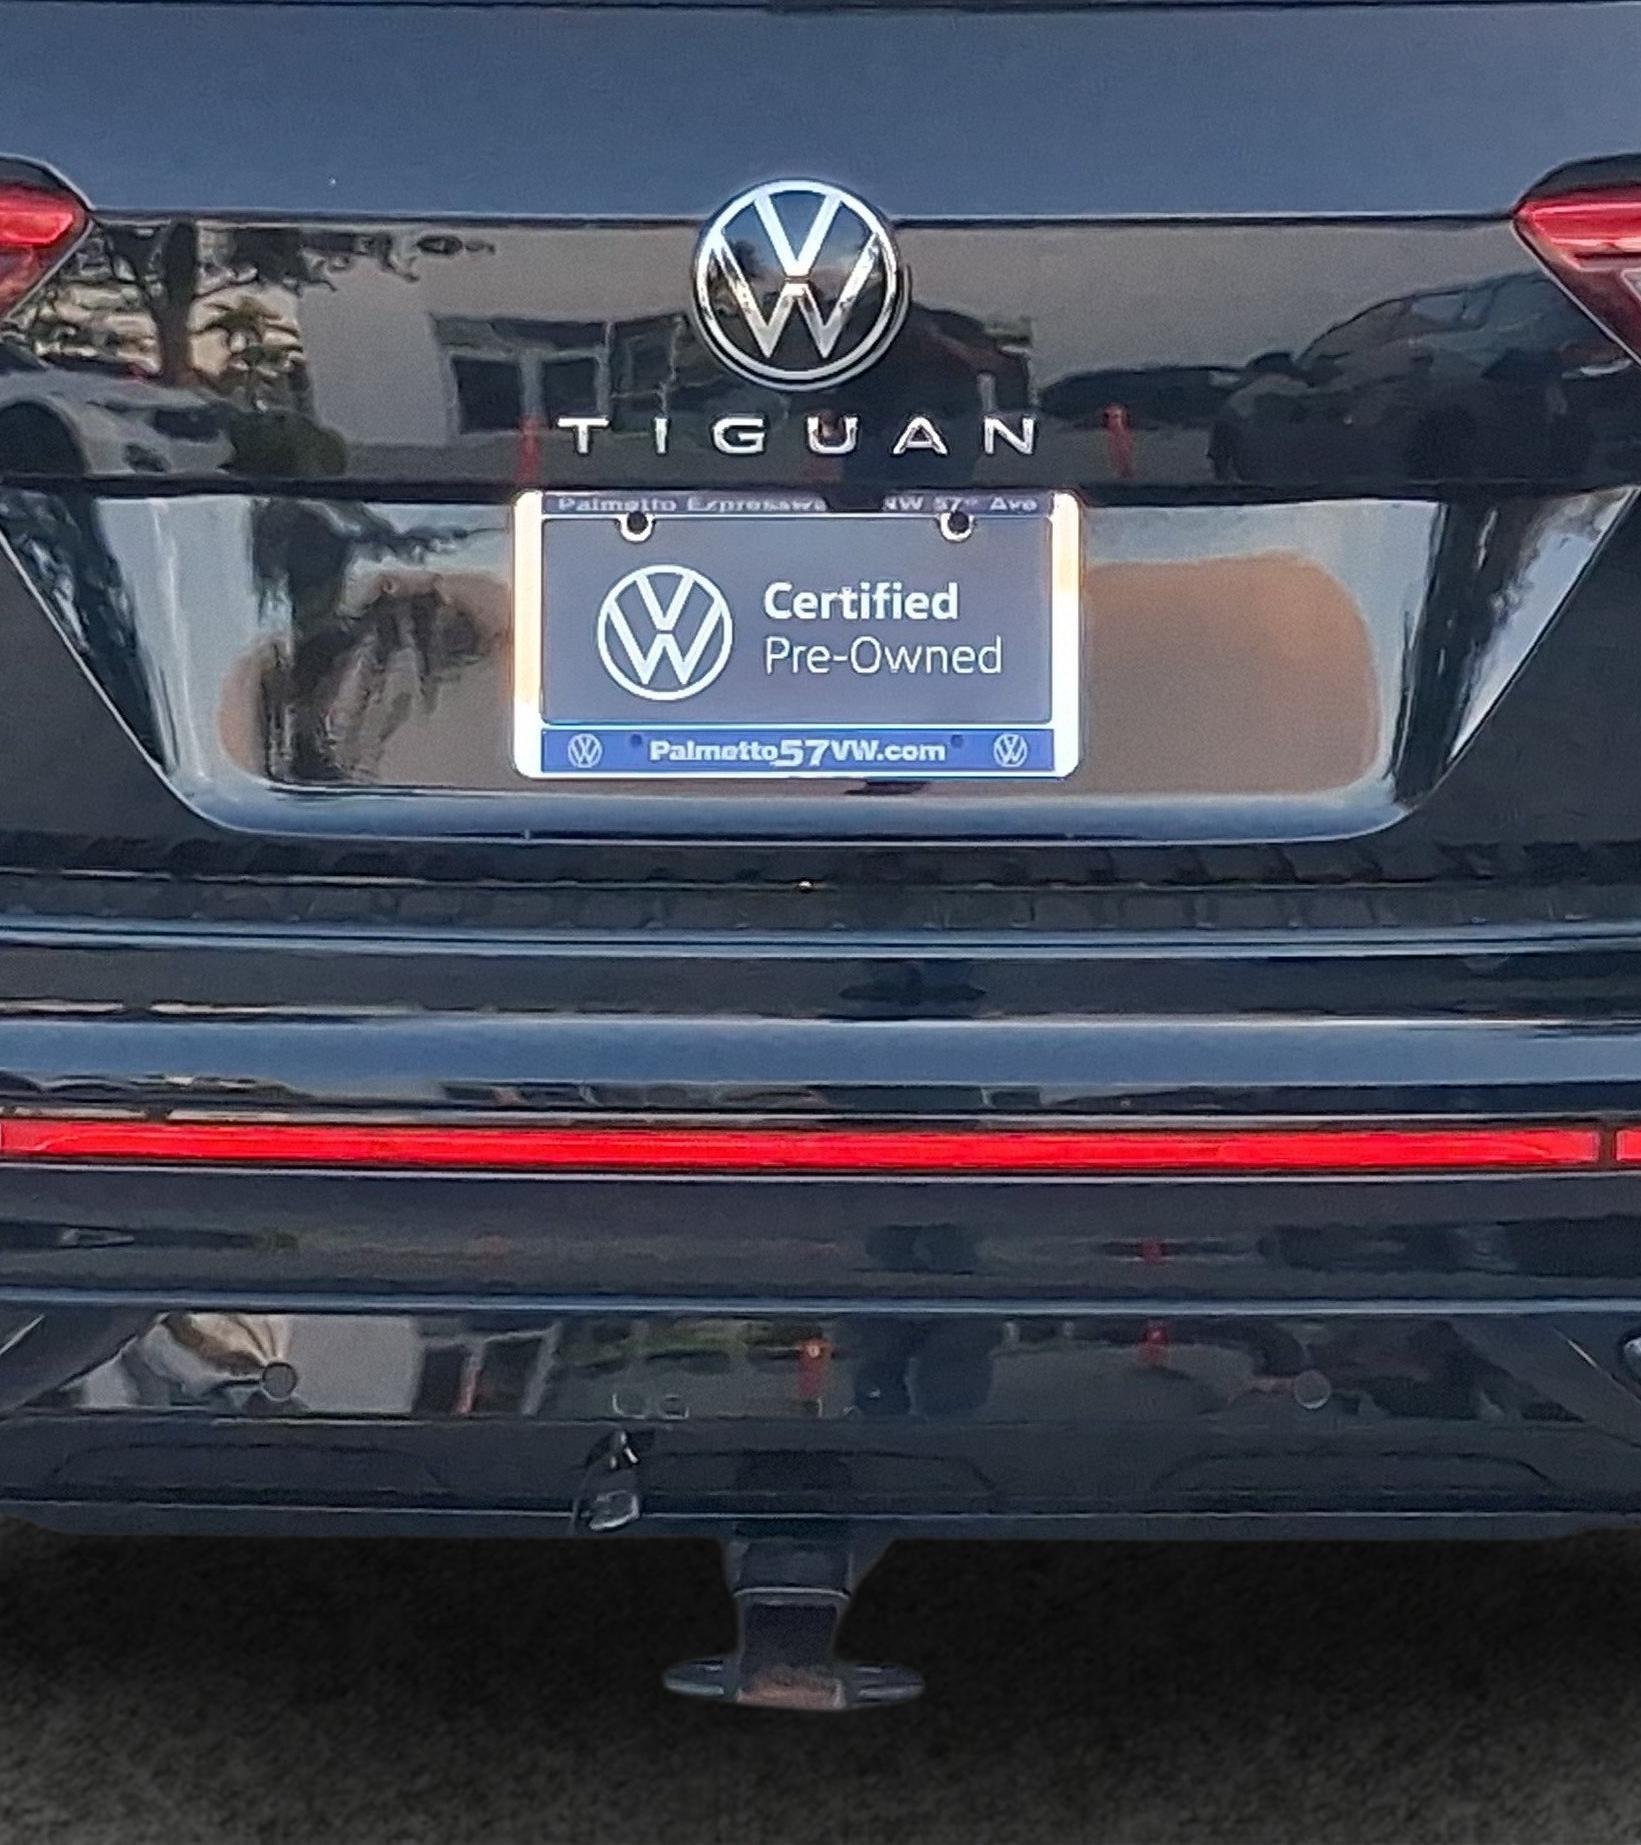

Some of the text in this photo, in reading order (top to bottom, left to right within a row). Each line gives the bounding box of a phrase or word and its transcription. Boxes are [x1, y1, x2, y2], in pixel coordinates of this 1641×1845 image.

[558, 415, 1037, 455] TIGUAN
[558, 495, 678, 513] Palmetto
[989, 496, 1039, 513] Ave
[763, 582, 959, 621] Certified
[765, 635, 1003, 675] Pre-Owned
[649, 739, 947, 768] Palmetto57VW.com
